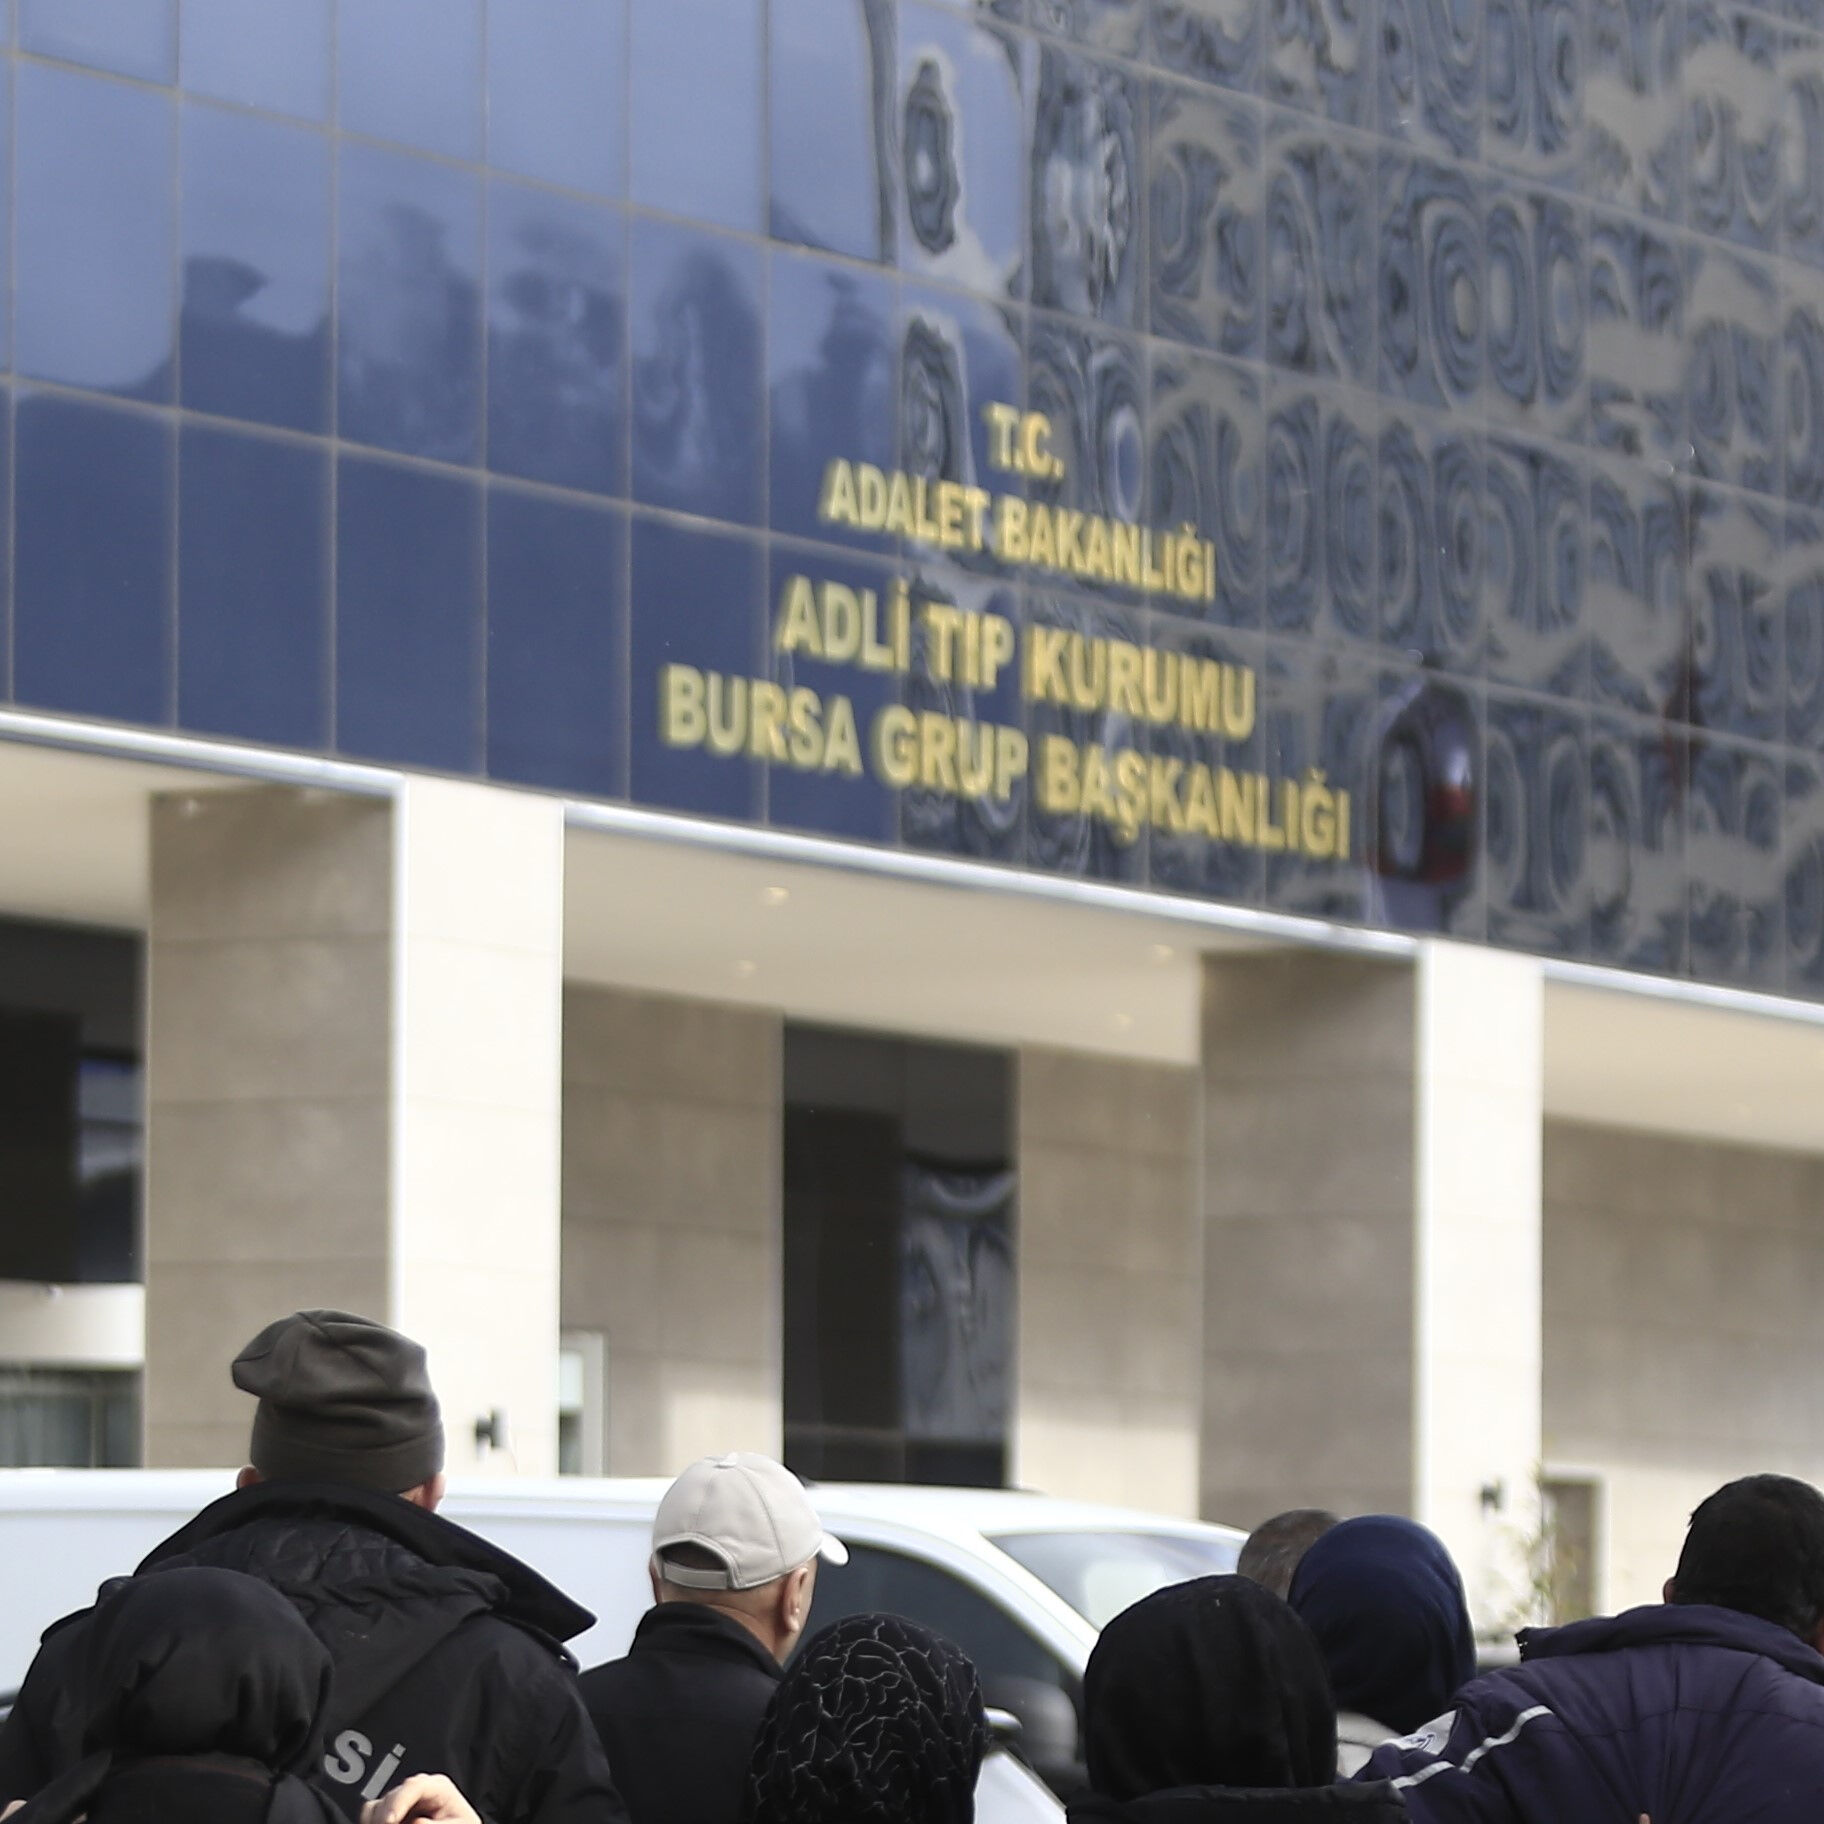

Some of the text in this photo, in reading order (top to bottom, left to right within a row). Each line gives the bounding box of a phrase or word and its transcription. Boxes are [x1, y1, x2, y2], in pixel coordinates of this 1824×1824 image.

[988, 404, 1065, 480] T.C.
[823, 461, 1215, 601] ADALET BAKANLIĞI
[777, 577, 1257, 741] ADLİ TIP KURUMU
[662, 666, 1351, 860] BURSA GRUP BAŞKANLIĞI
